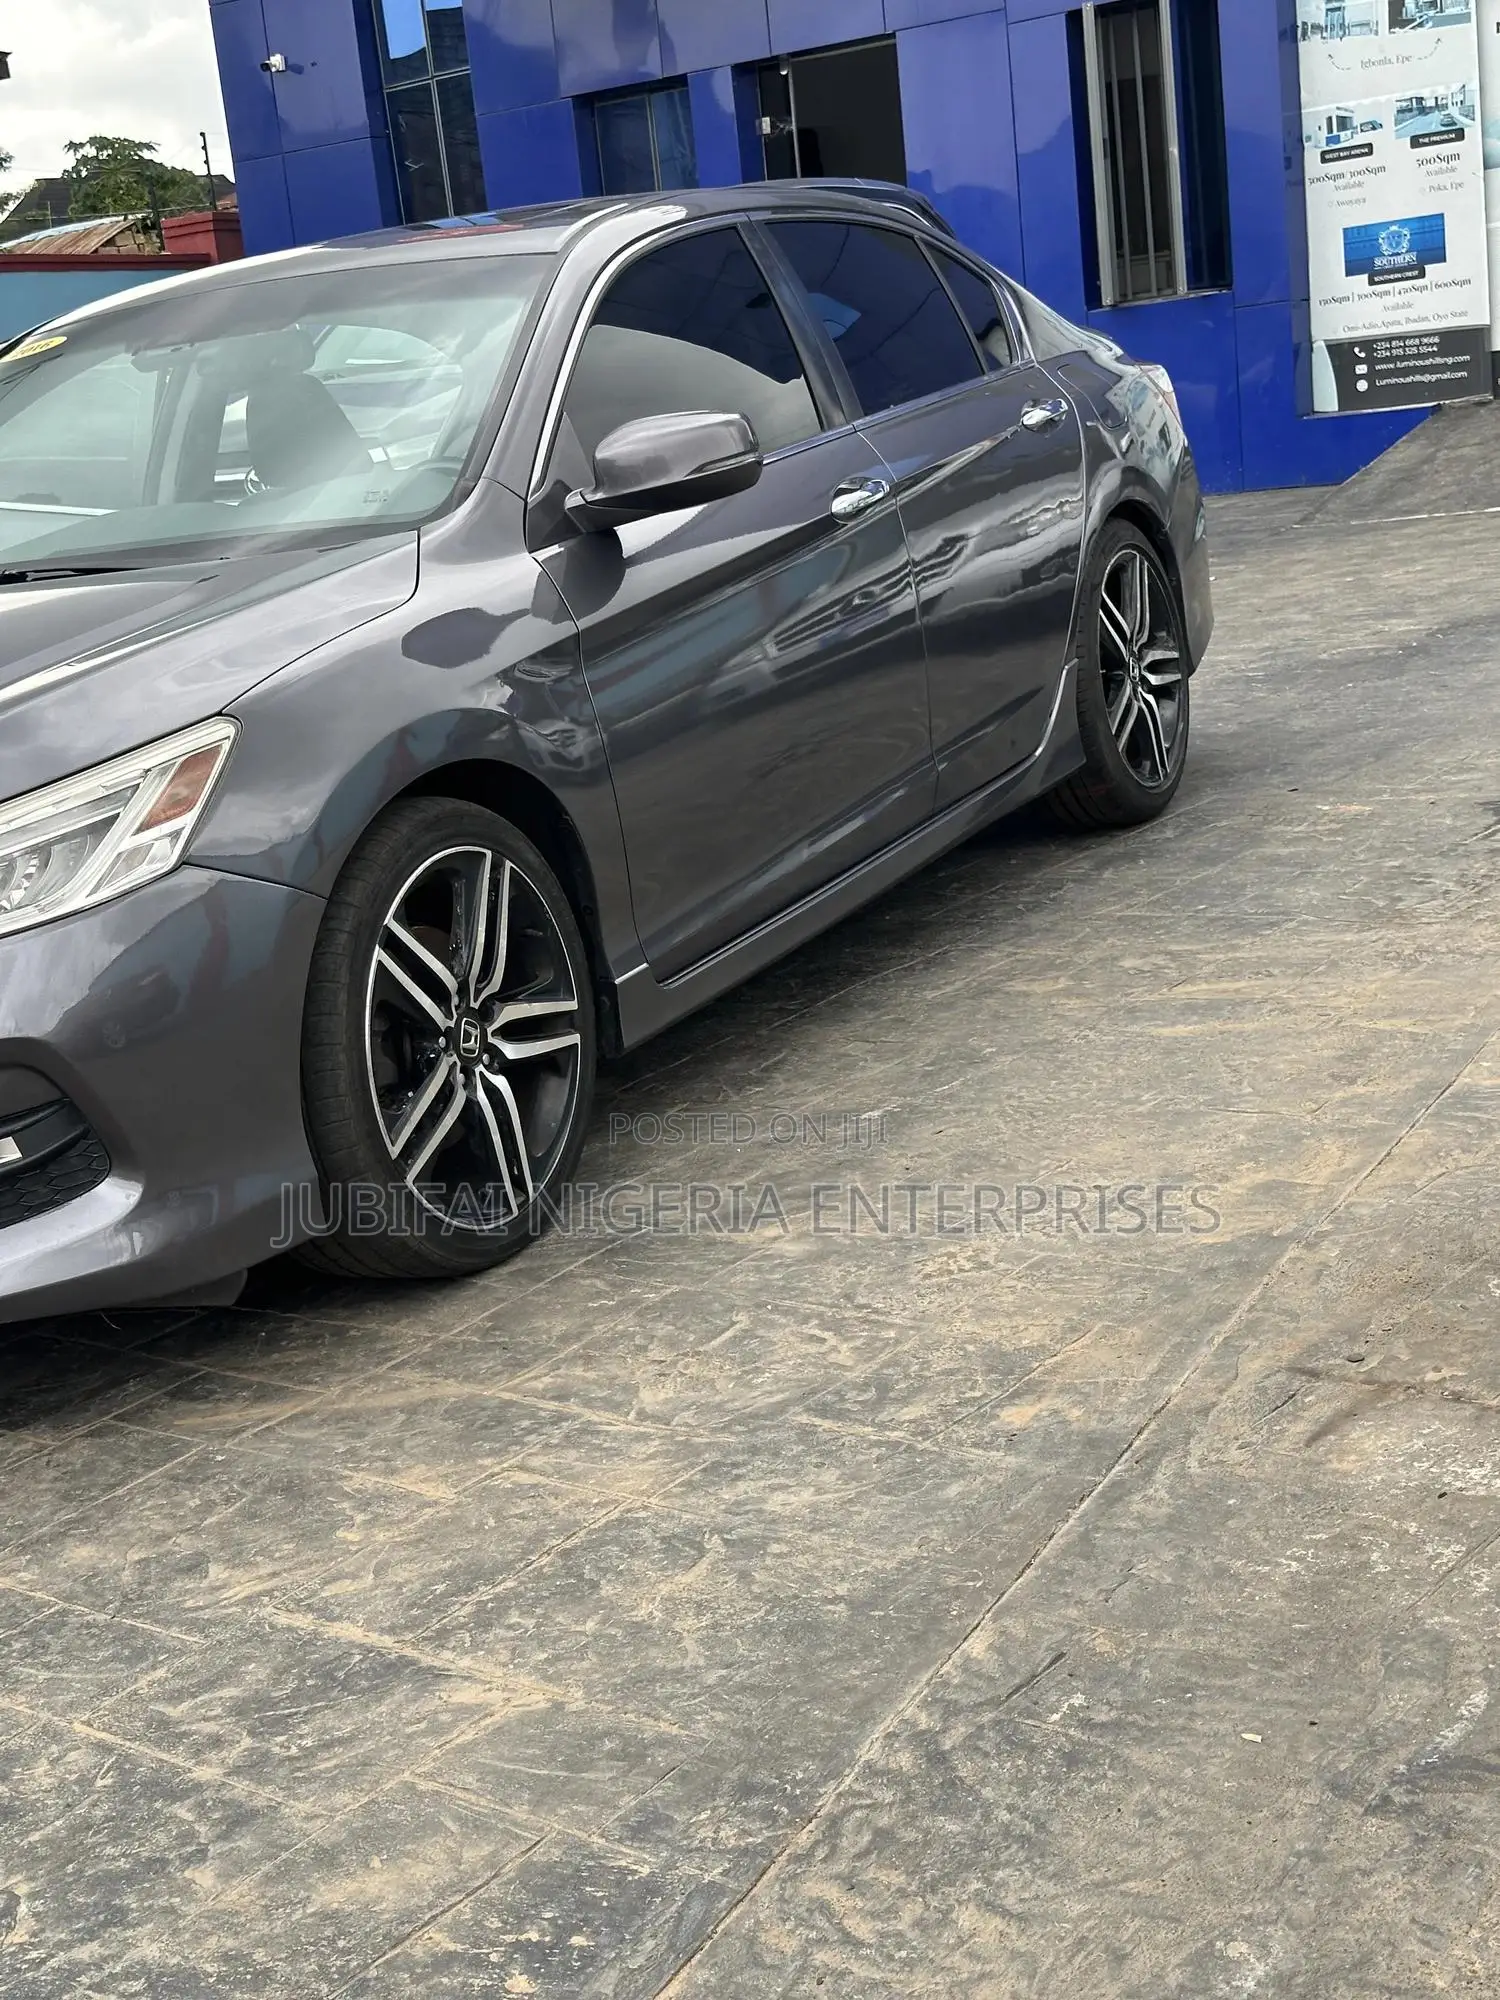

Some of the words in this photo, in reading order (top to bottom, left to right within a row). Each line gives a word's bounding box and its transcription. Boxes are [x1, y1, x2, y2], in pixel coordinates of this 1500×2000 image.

[1396, 55, 1412, 65] Epe
[1430, 133, 1456, 142] PREMIUM
[1416, 152, 1461, 168] 500Sqm
[1424, 165, 1458, 177] Available
[1333, 180, 1365, 192] Available
[1450, 181, 1465, 192] Epe
[1373, 252, 1417, 267] SOUTHERN
[1374, 273, 1401, 282] SOUTHERN
[1381, 301, 1414, 313] Available
[1450, 310, 1468, 319] State
[1373, 341, 1390, 350] +234
[1373, 349, 1390, 358] +234
